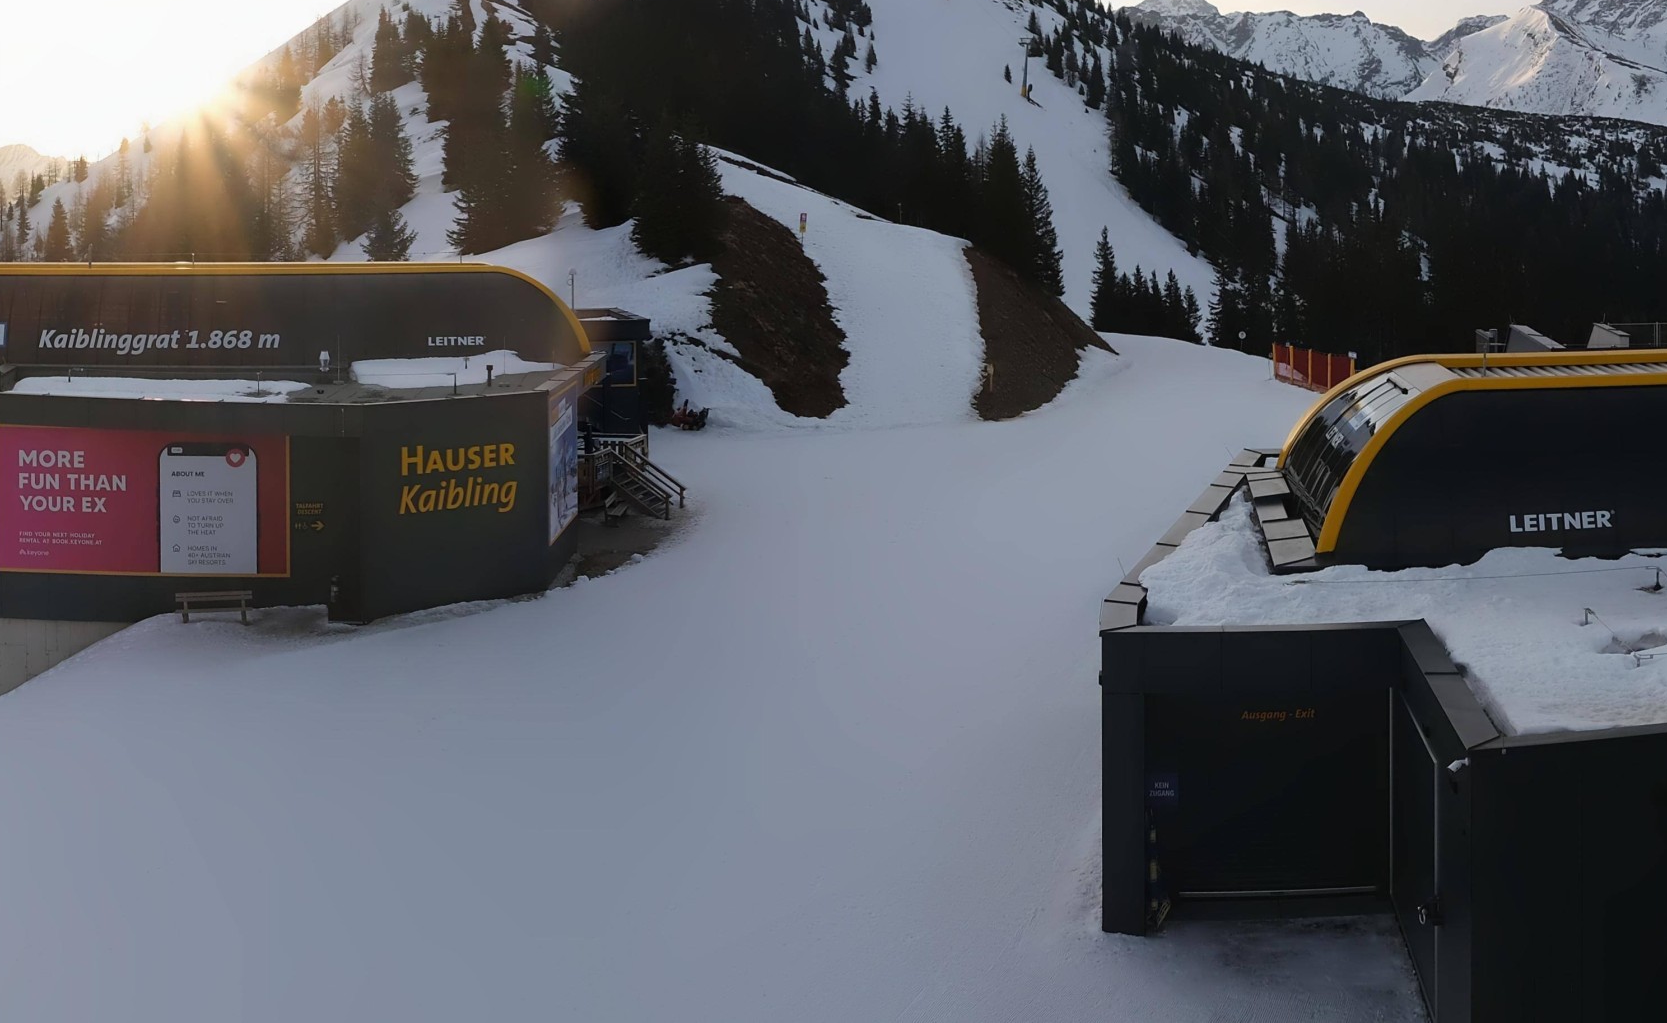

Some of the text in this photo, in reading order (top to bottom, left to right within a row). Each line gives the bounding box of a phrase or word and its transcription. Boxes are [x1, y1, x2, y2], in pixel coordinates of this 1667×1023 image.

[39, 329, 280, 355] Kaiblinggrat 1.868 m
[428, 336, 484, 346] LEITNER
[18, 449, 85, 468] MORE
[401, 443, 515, 475] HAUSER
[18, 473, 127, 491] FUN THAN
[20, 495, 107, 513] YOUR EX
[399, 477, 517, 514] Kaibling
[1510, 511, 1612, 532] LEITNER
[1241, 710, 1286, 721] Ausgang
[1295, 709, 1316, 718] Exit
[1149, 789, 1175, 797] ZUGANG
[1154, 781, 1169, 789] KEIN
